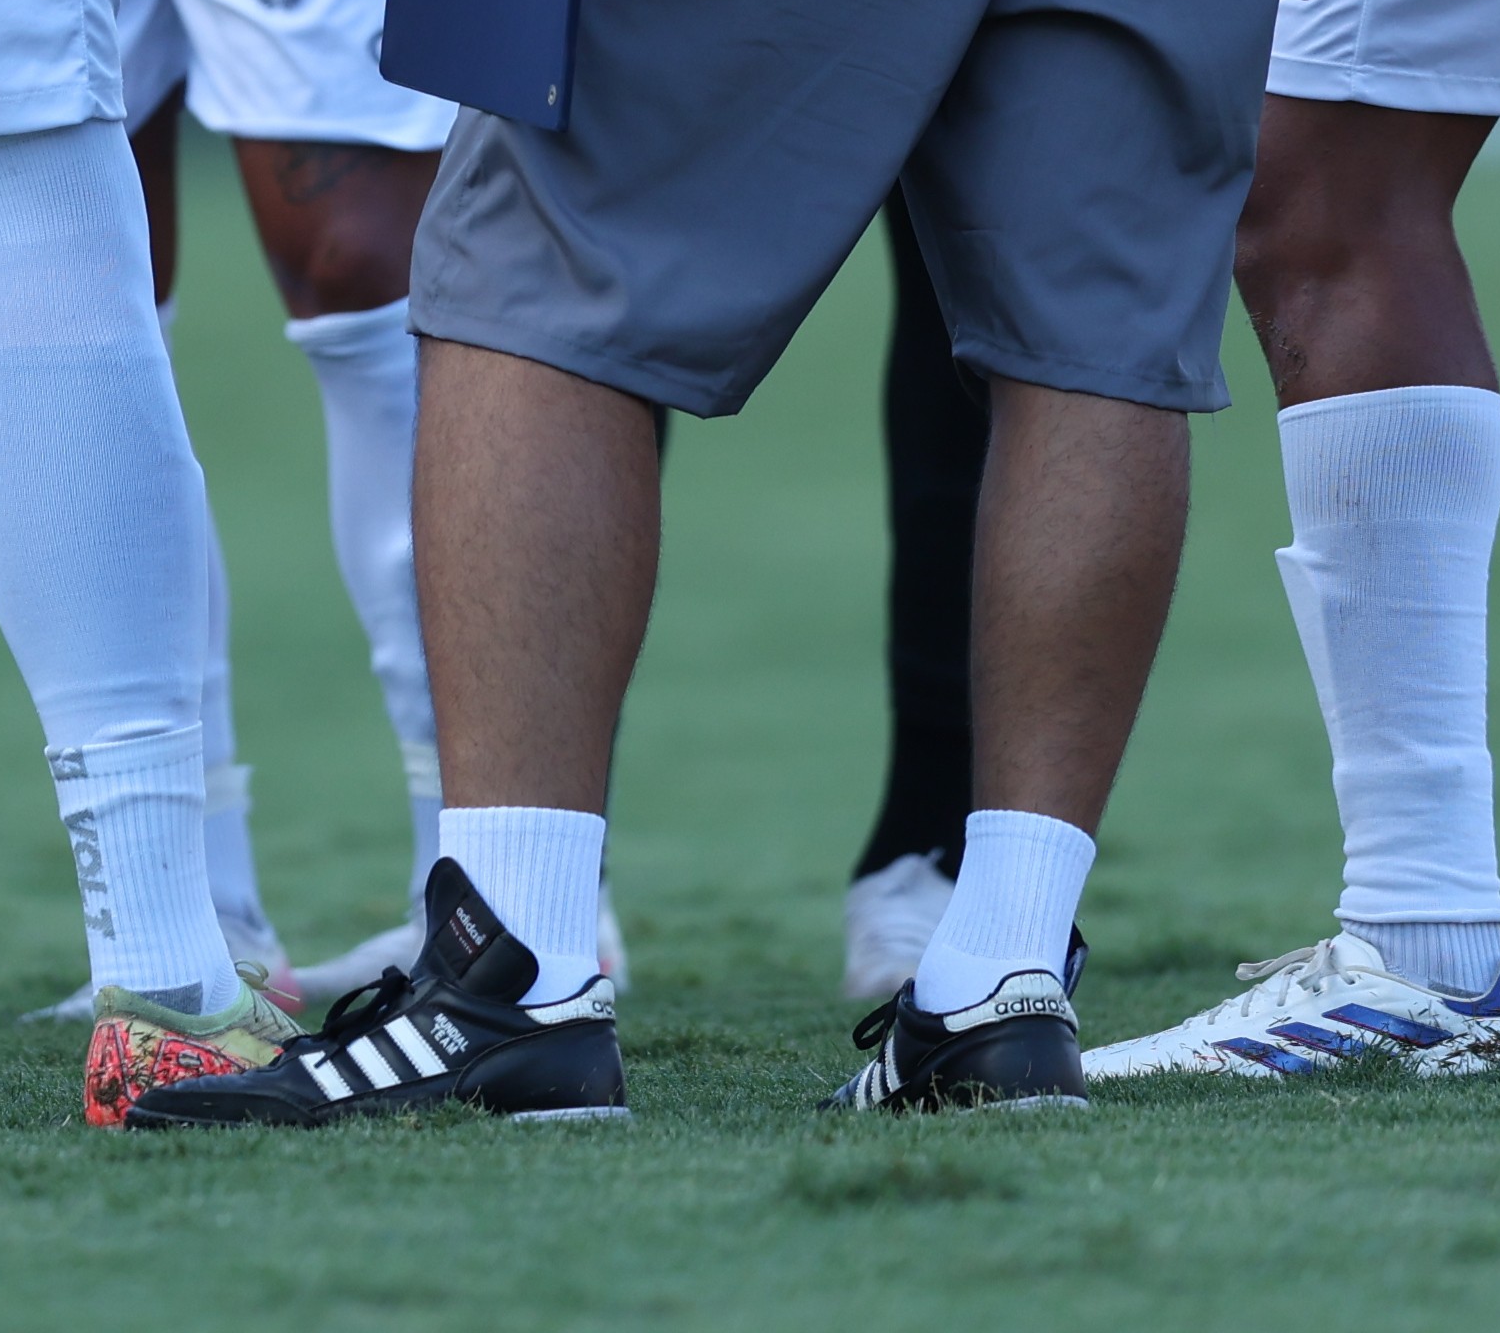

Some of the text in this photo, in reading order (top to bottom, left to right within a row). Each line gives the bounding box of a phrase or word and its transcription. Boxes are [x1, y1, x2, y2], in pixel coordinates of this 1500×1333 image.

[456, 906, 486, 946] adidas
[995, 996, 1067, 1015] adidas
[430, 1022, 459, 1056] TEAM
[433, 1012, 469, 1053] MUNDIAL
